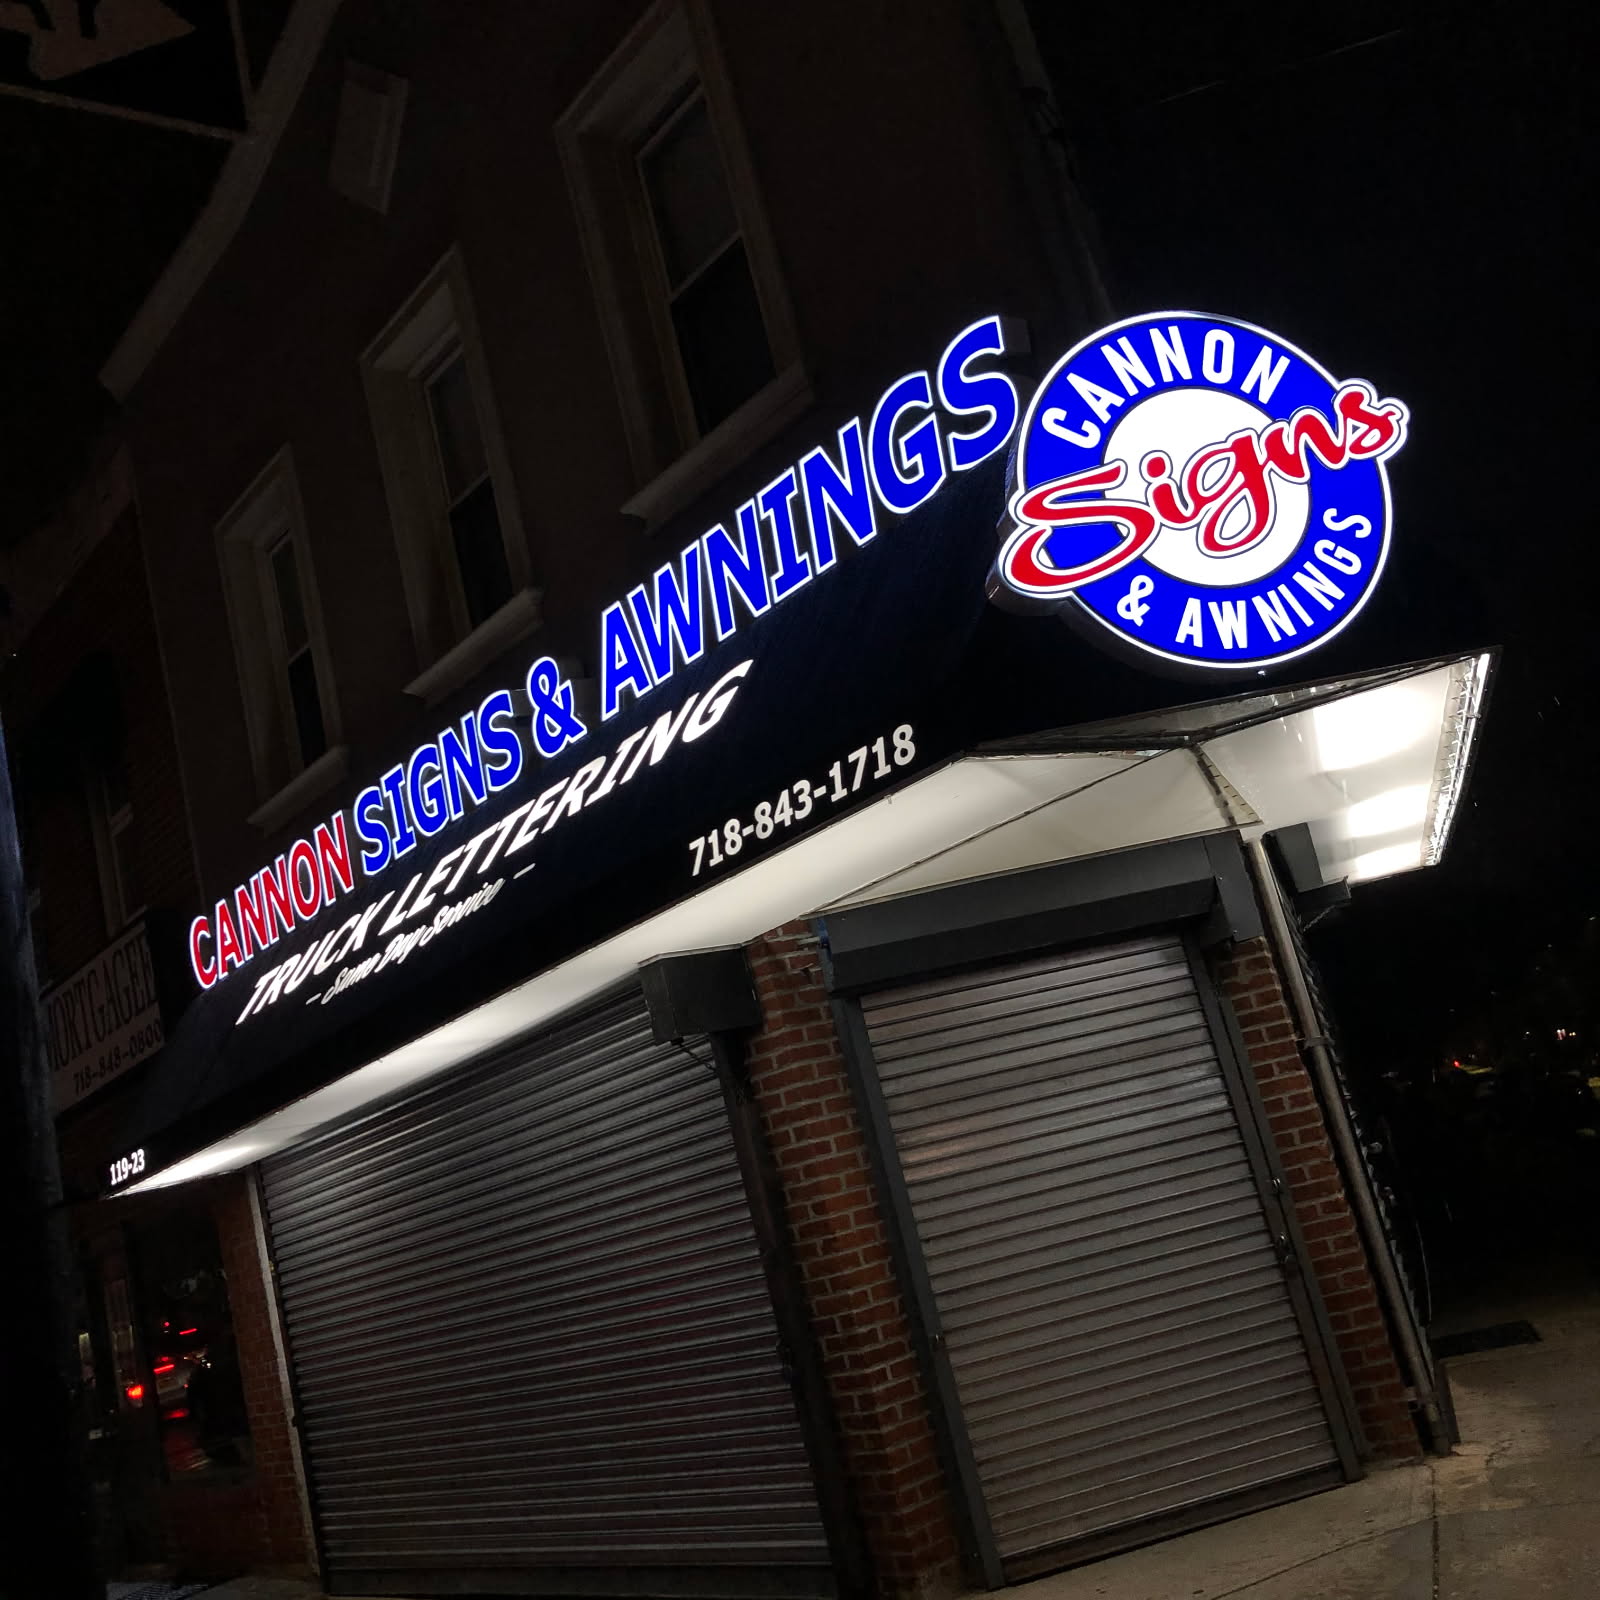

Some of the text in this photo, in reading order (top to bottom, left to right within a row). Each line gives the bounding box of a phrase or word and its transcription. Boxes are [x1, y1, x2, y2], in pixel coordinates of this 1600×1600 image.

[1041, 325, 1291, 449] CANNON
[1009, 389, 1405, 589] Signs
[1116, 507, 1373, 649] & AWNINGS
[187, 315, 1020, 991] CANNON SIGNS & AWNINGS
[235, 659, 754, 1026] TRUCK LETTERING
[688, 724, 916, 876] 718-843-1718
[374, 925, 427, 973] Day
[418, 878, 505, 947] Service
[109, 1148, 145, 1186] 119-23
